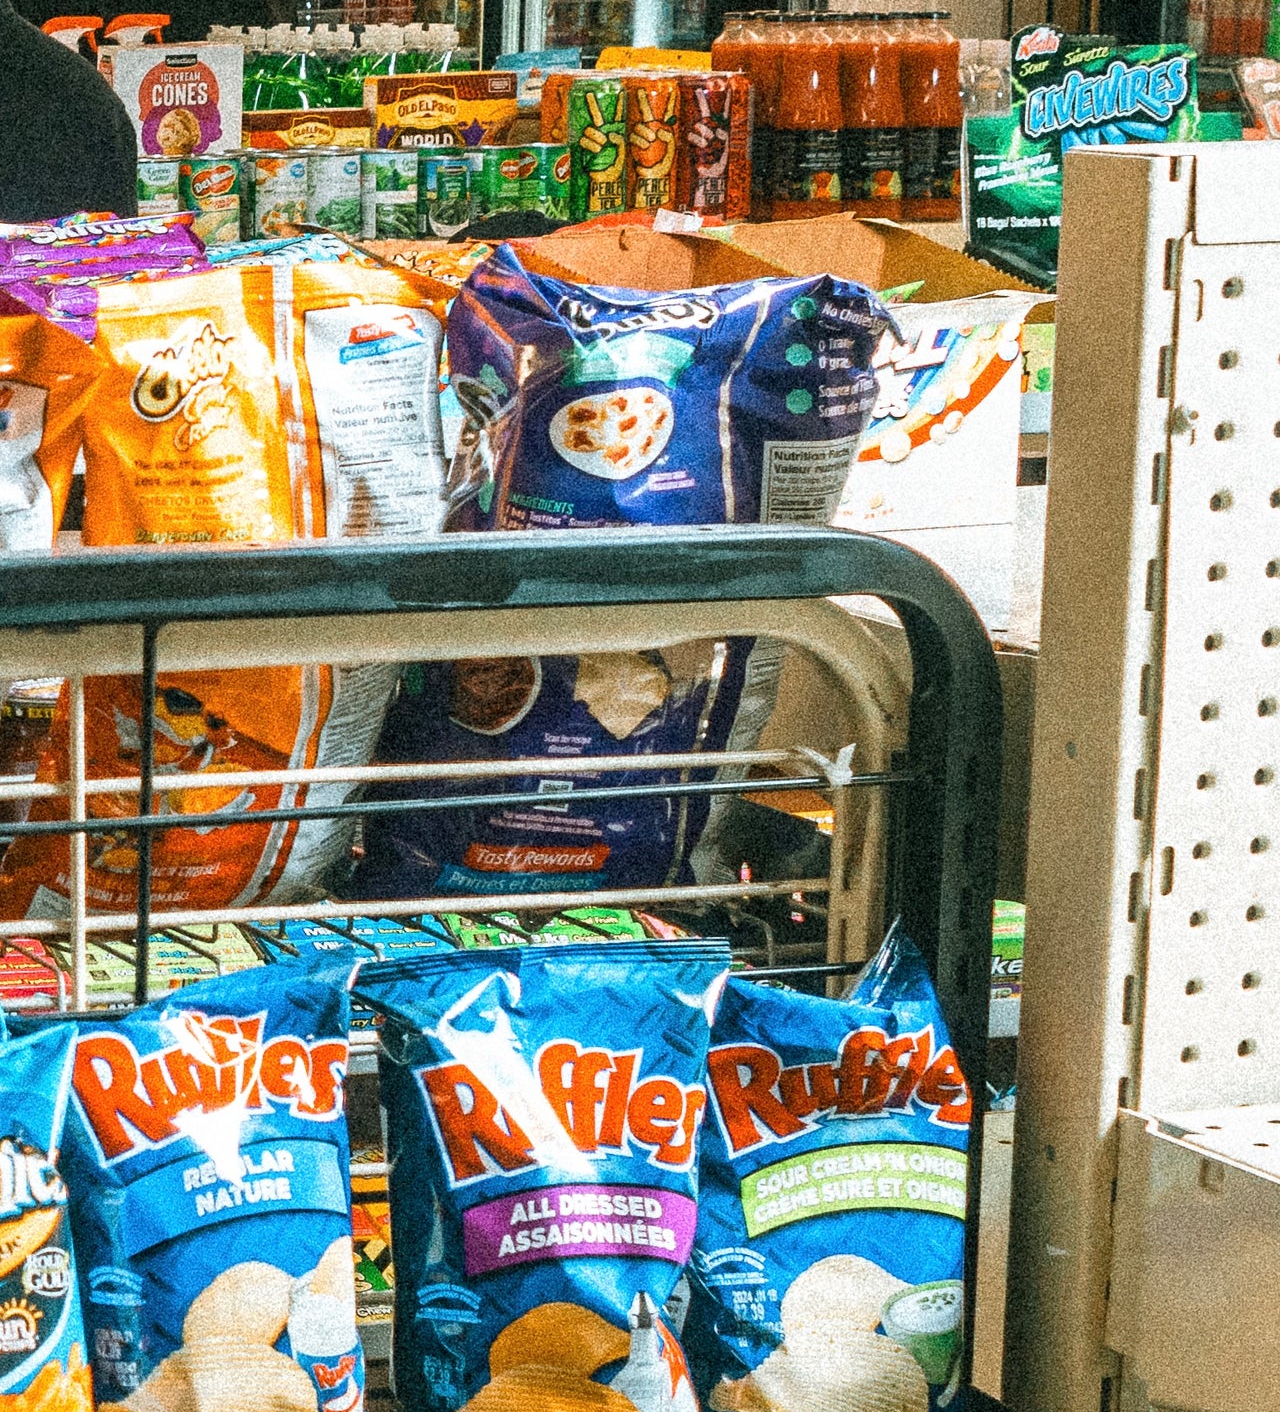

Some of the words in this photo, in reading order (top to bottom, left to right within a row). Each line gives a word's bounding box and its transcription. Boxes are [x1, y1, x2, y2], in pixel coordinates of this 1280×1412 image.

[160, 72, 174, 83] ICE
[175, 71, 201, 82] CREAM
[1020, 60, 1050, 78] Sour
[151, 82, 209, 107] CONES
[1027, 59, 1189, 136] LIVEWIRES
[638, 178, 670, 194] PEACE
[822, 304, 837, 317] No
[383, 400, 414, 410] Facts
[334, 416, 369, 429] Valeur
[773, 451, 825, 463] Nutrition
[773, 463, 812, 474] Valeur
[476, 849, 521, 867] Tasty
[523, 849, 596, 866] Rewards
[706, 1025, 973, 1157] Ruffles
[756, 1161, 810, 1199] SOUR
[810, 1151, 881, 1182] CREAM
[195, 1181, 292, 1217] NATURE
[510, 1199, 556, 1224] ALL
[557, 1191, 663, 1221] DRESSED
[753, 1187, 821, 1224] CRÈME
[822, 1180, 874, 1208] SURE
[877, 1176, 902, 1203] ET
[498, 1219, 677, 1258] ASSAISONNÉES
